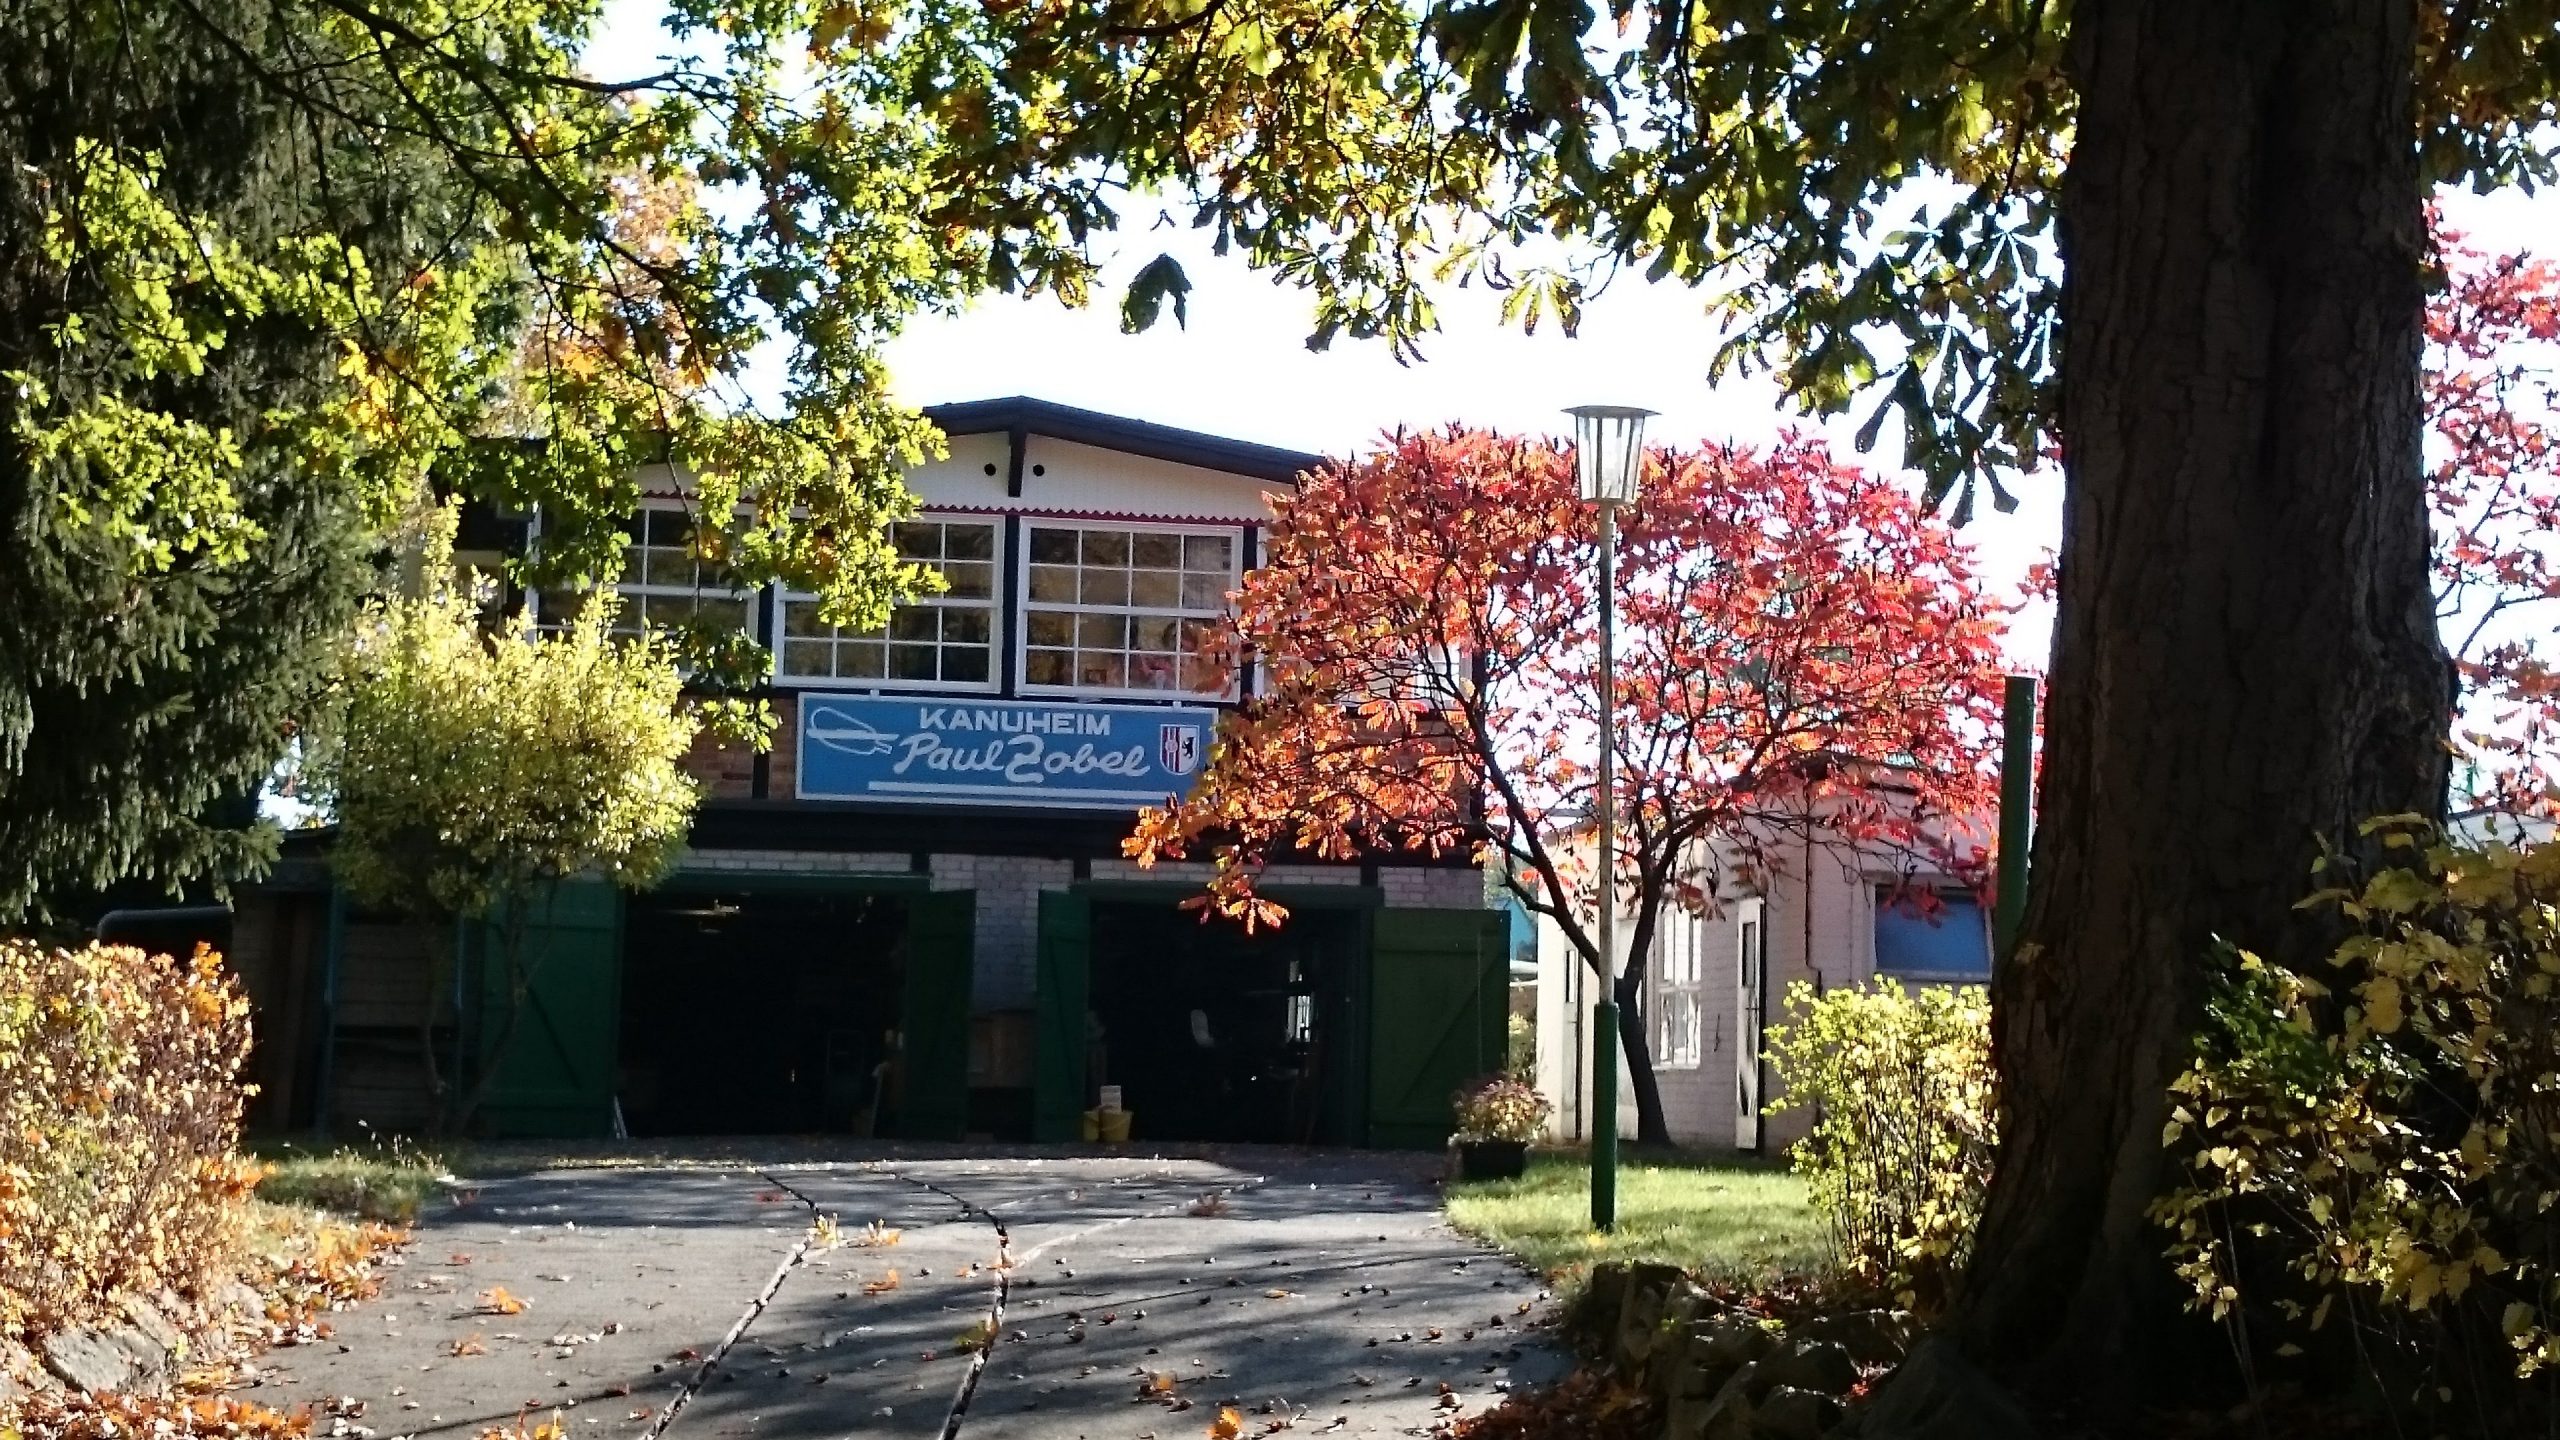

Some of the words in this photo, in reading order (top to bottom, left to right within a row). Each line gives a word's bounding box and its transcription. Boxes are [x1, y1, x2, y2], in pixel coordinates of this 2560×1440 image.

[920, 707, 1110, 735] KANUHEIM
[893, 733, 1005, 774] Paul
[1005, 735, 1151, 783] Zobel
